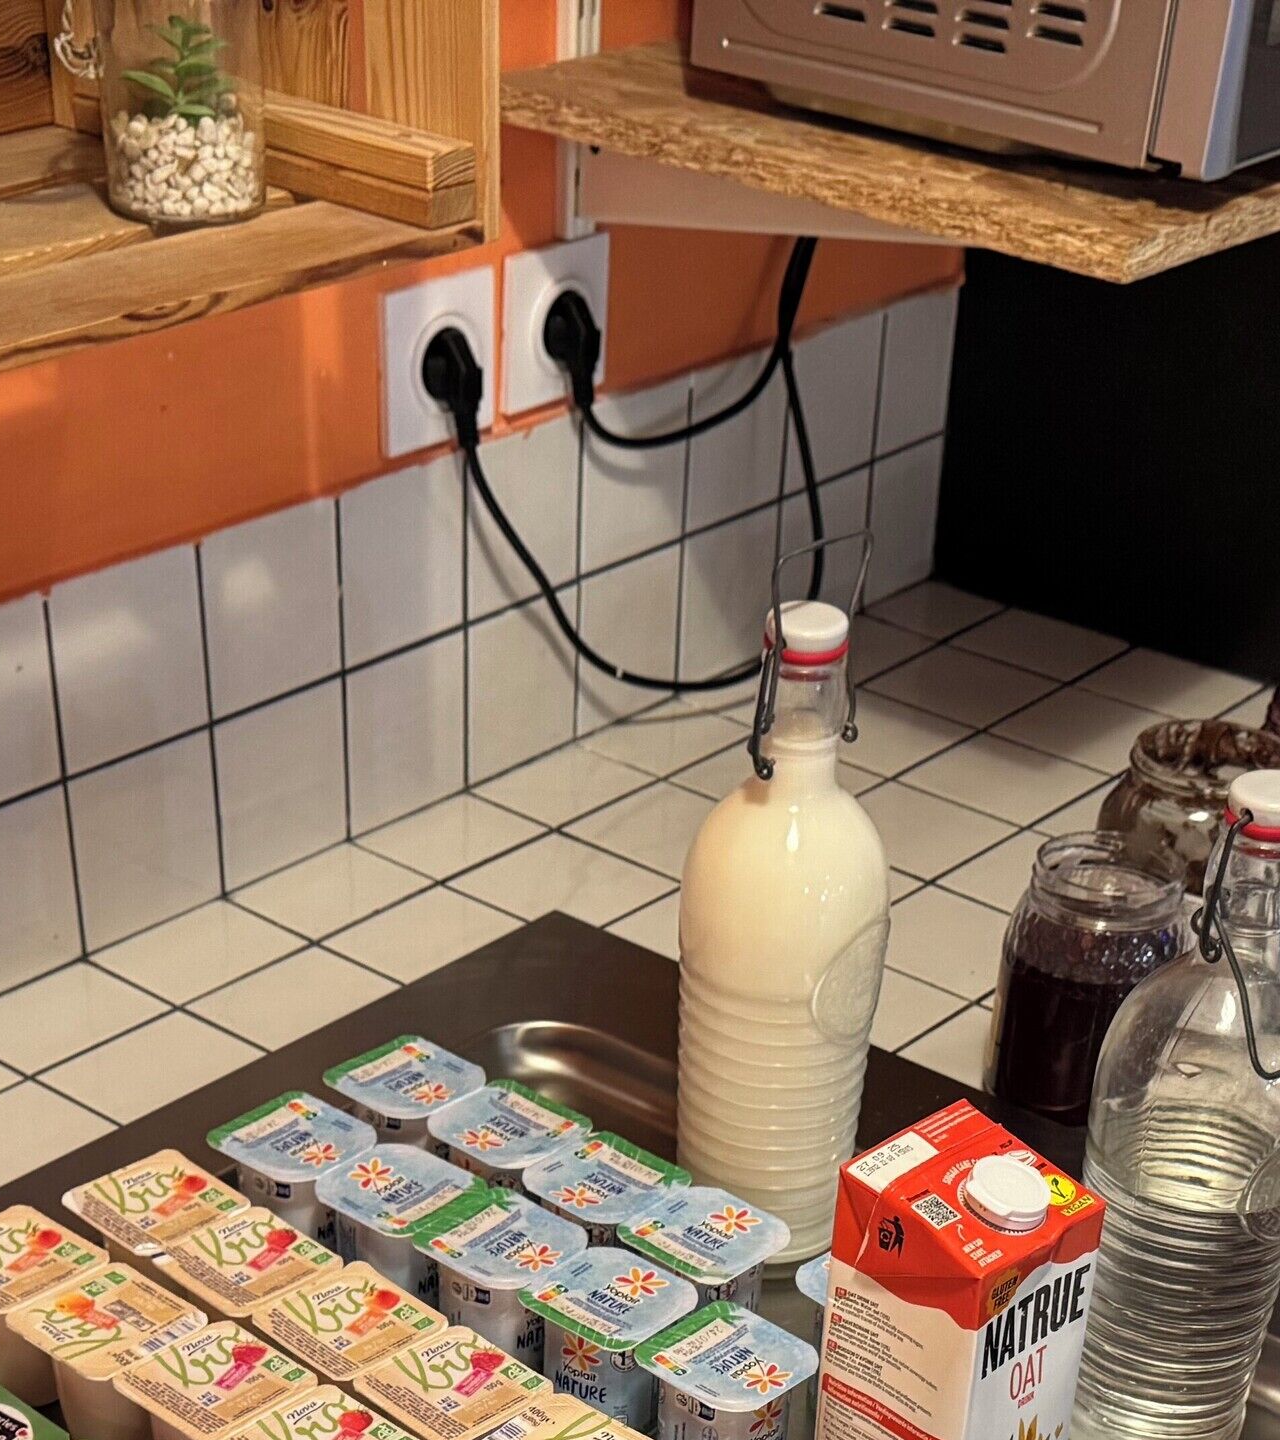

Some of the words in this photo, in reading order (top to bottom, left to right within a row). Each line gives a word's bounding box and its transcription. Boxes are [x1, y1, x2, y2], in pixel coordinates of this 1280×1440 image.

[1065, 1195, 1092, 1216] VEGAN
[685, 1226, 729, 1249] NATURE
[312, 1285, 342, 1301] Nova
[991, 1274, 1019, 1300] GLUTEN
[588, 1290, 634, 1315] NATURE
[993, 1290, 1011, 1311] FREE
[981, 1263, 1091, 1380] NATRUE
[182, 1334, 213, 1352] Nova
[421, 1341, 450, 1358] Nova
[562, 1361, 597, 1381] Yoplait
[711, 1347, 754, 1375] NATURE
[1010, 1345, 1047, 1400] OAT
[555, 1371, 607, 1403] NATURE
[287, 1401, 317, 1420] Nova
